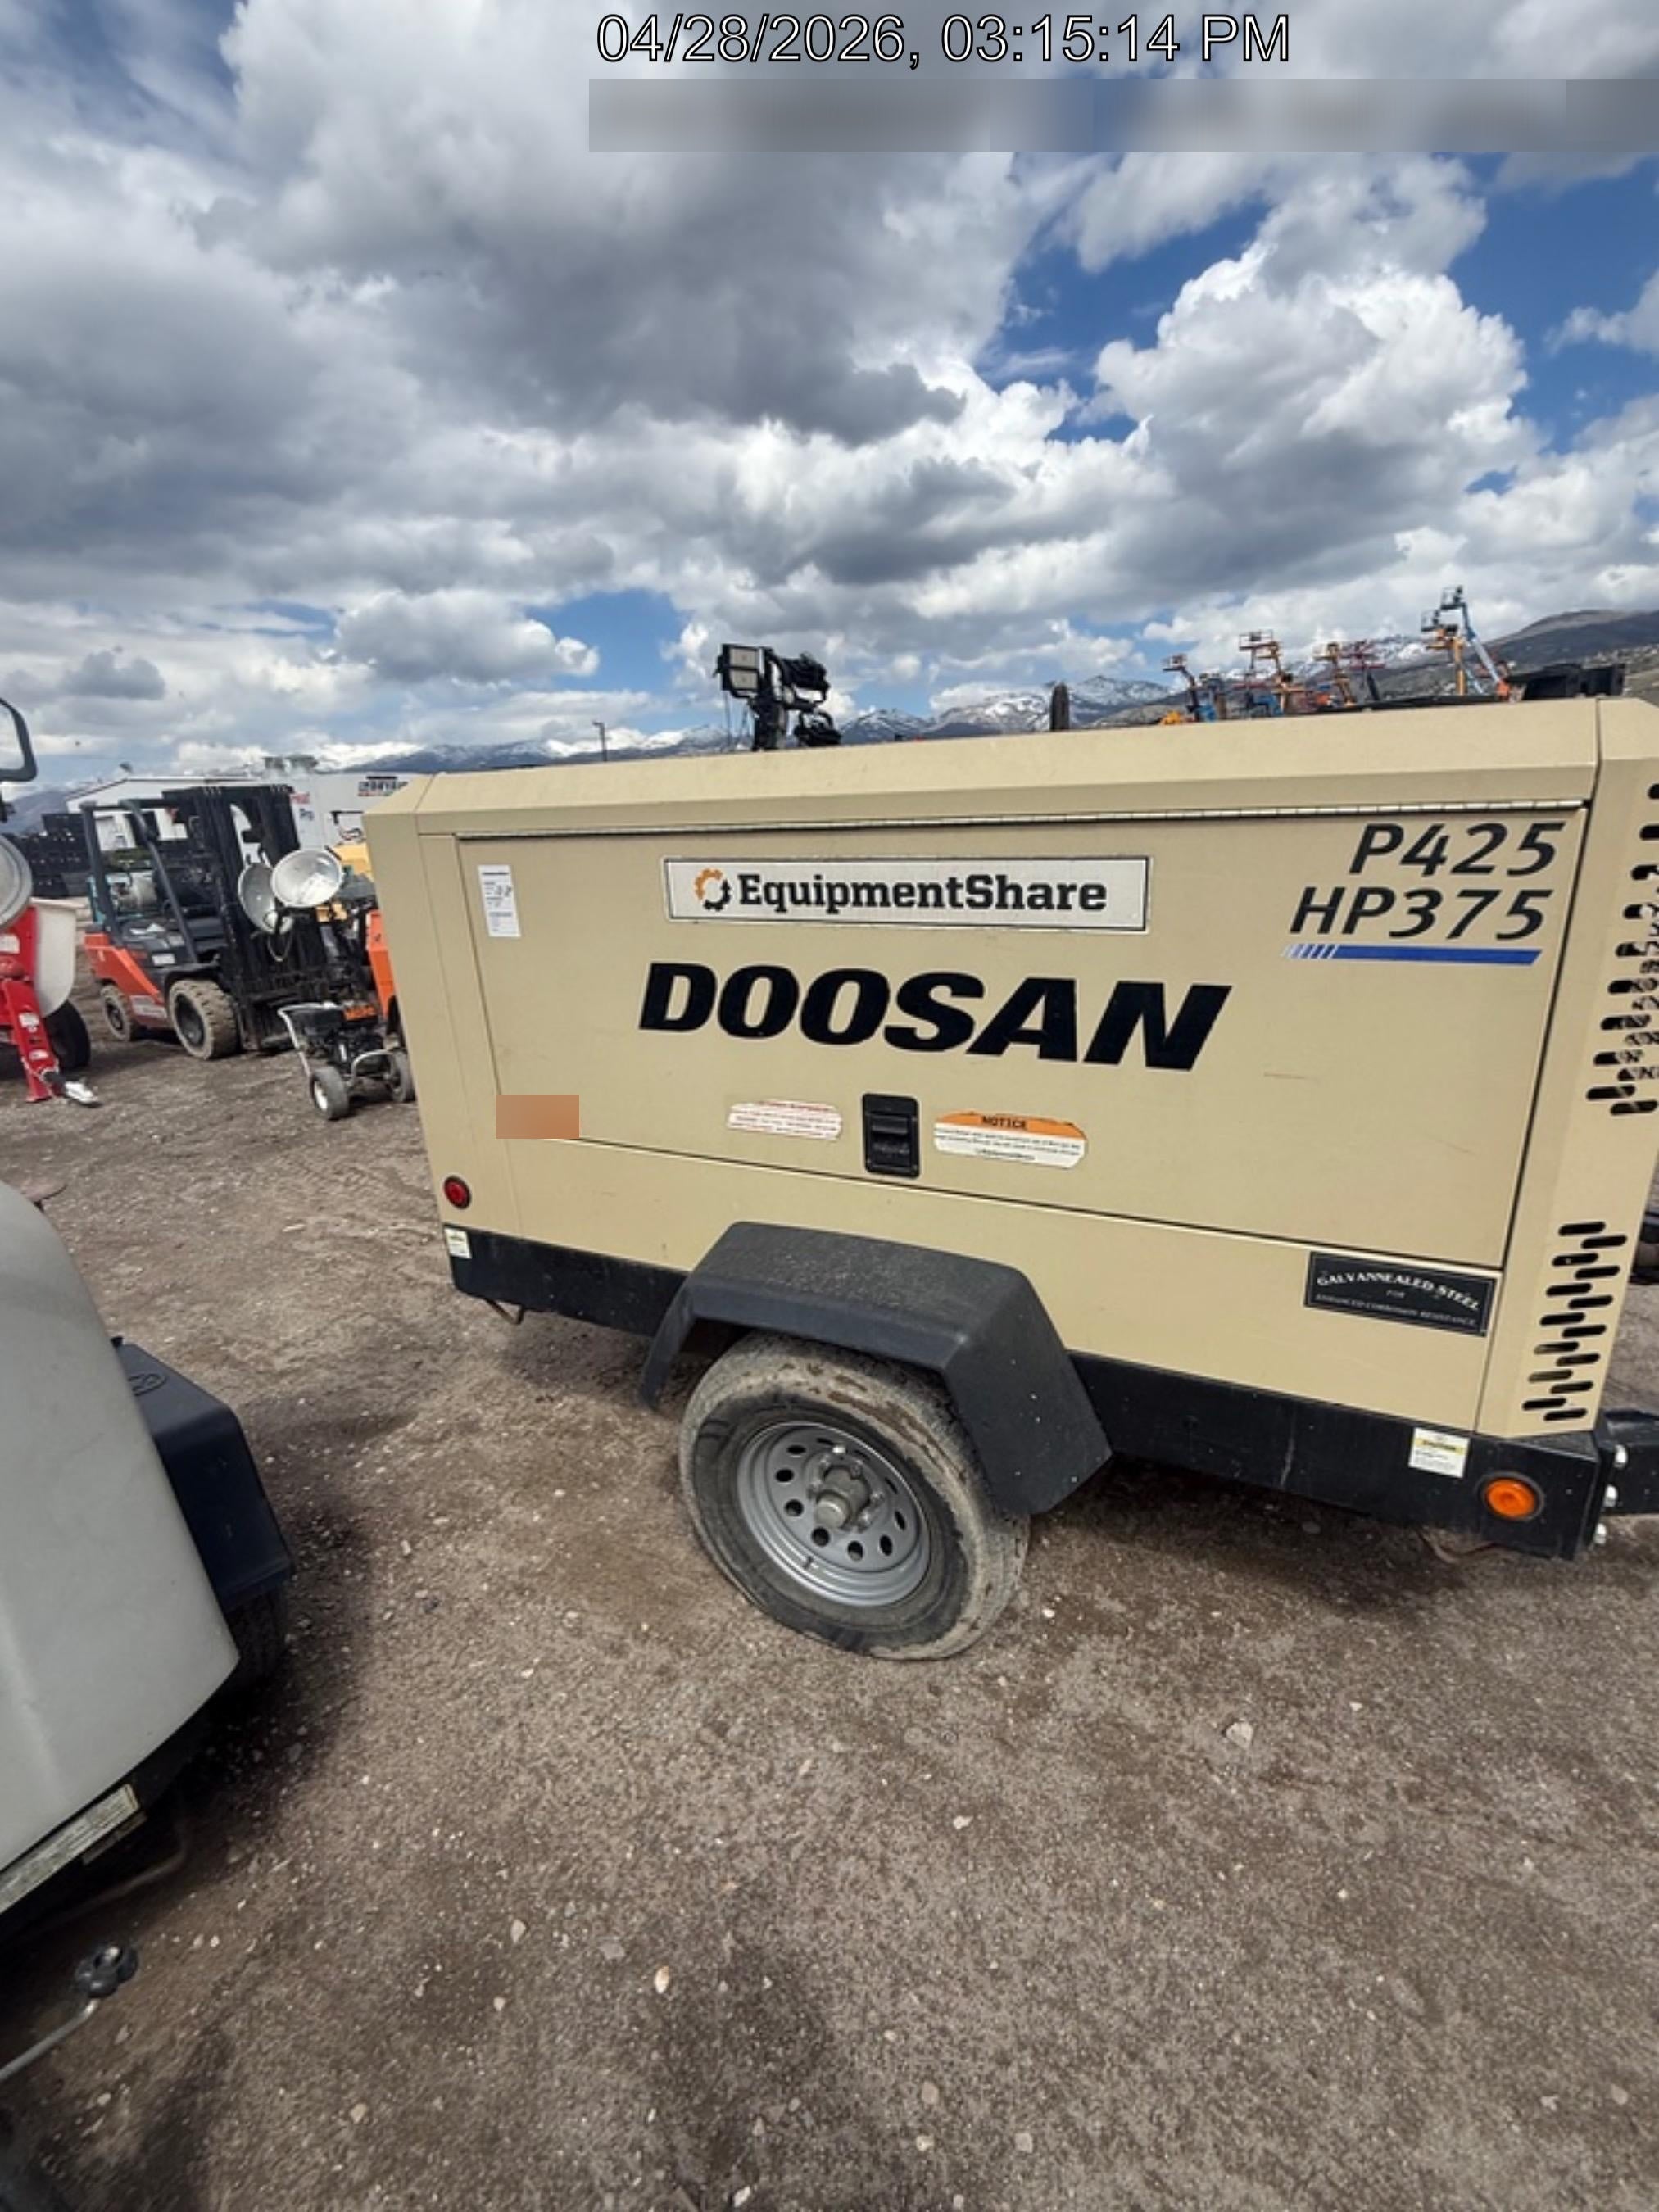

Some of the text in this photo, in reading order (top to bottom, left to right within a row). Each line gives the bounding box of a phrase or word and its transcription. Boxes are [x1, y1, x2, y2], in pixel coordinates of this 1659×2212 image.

[1349, 822, 1566, 877] P425
[738, 873, 1107, 914] EquipmentShare
[1290, 886, 1554, 940] HP375
[639, 962, 1232, 1071] DOOSAN
[982, 1115, 1027, 1131] NOTICE
[1435, 1284, 1480, 1310] STEEL
